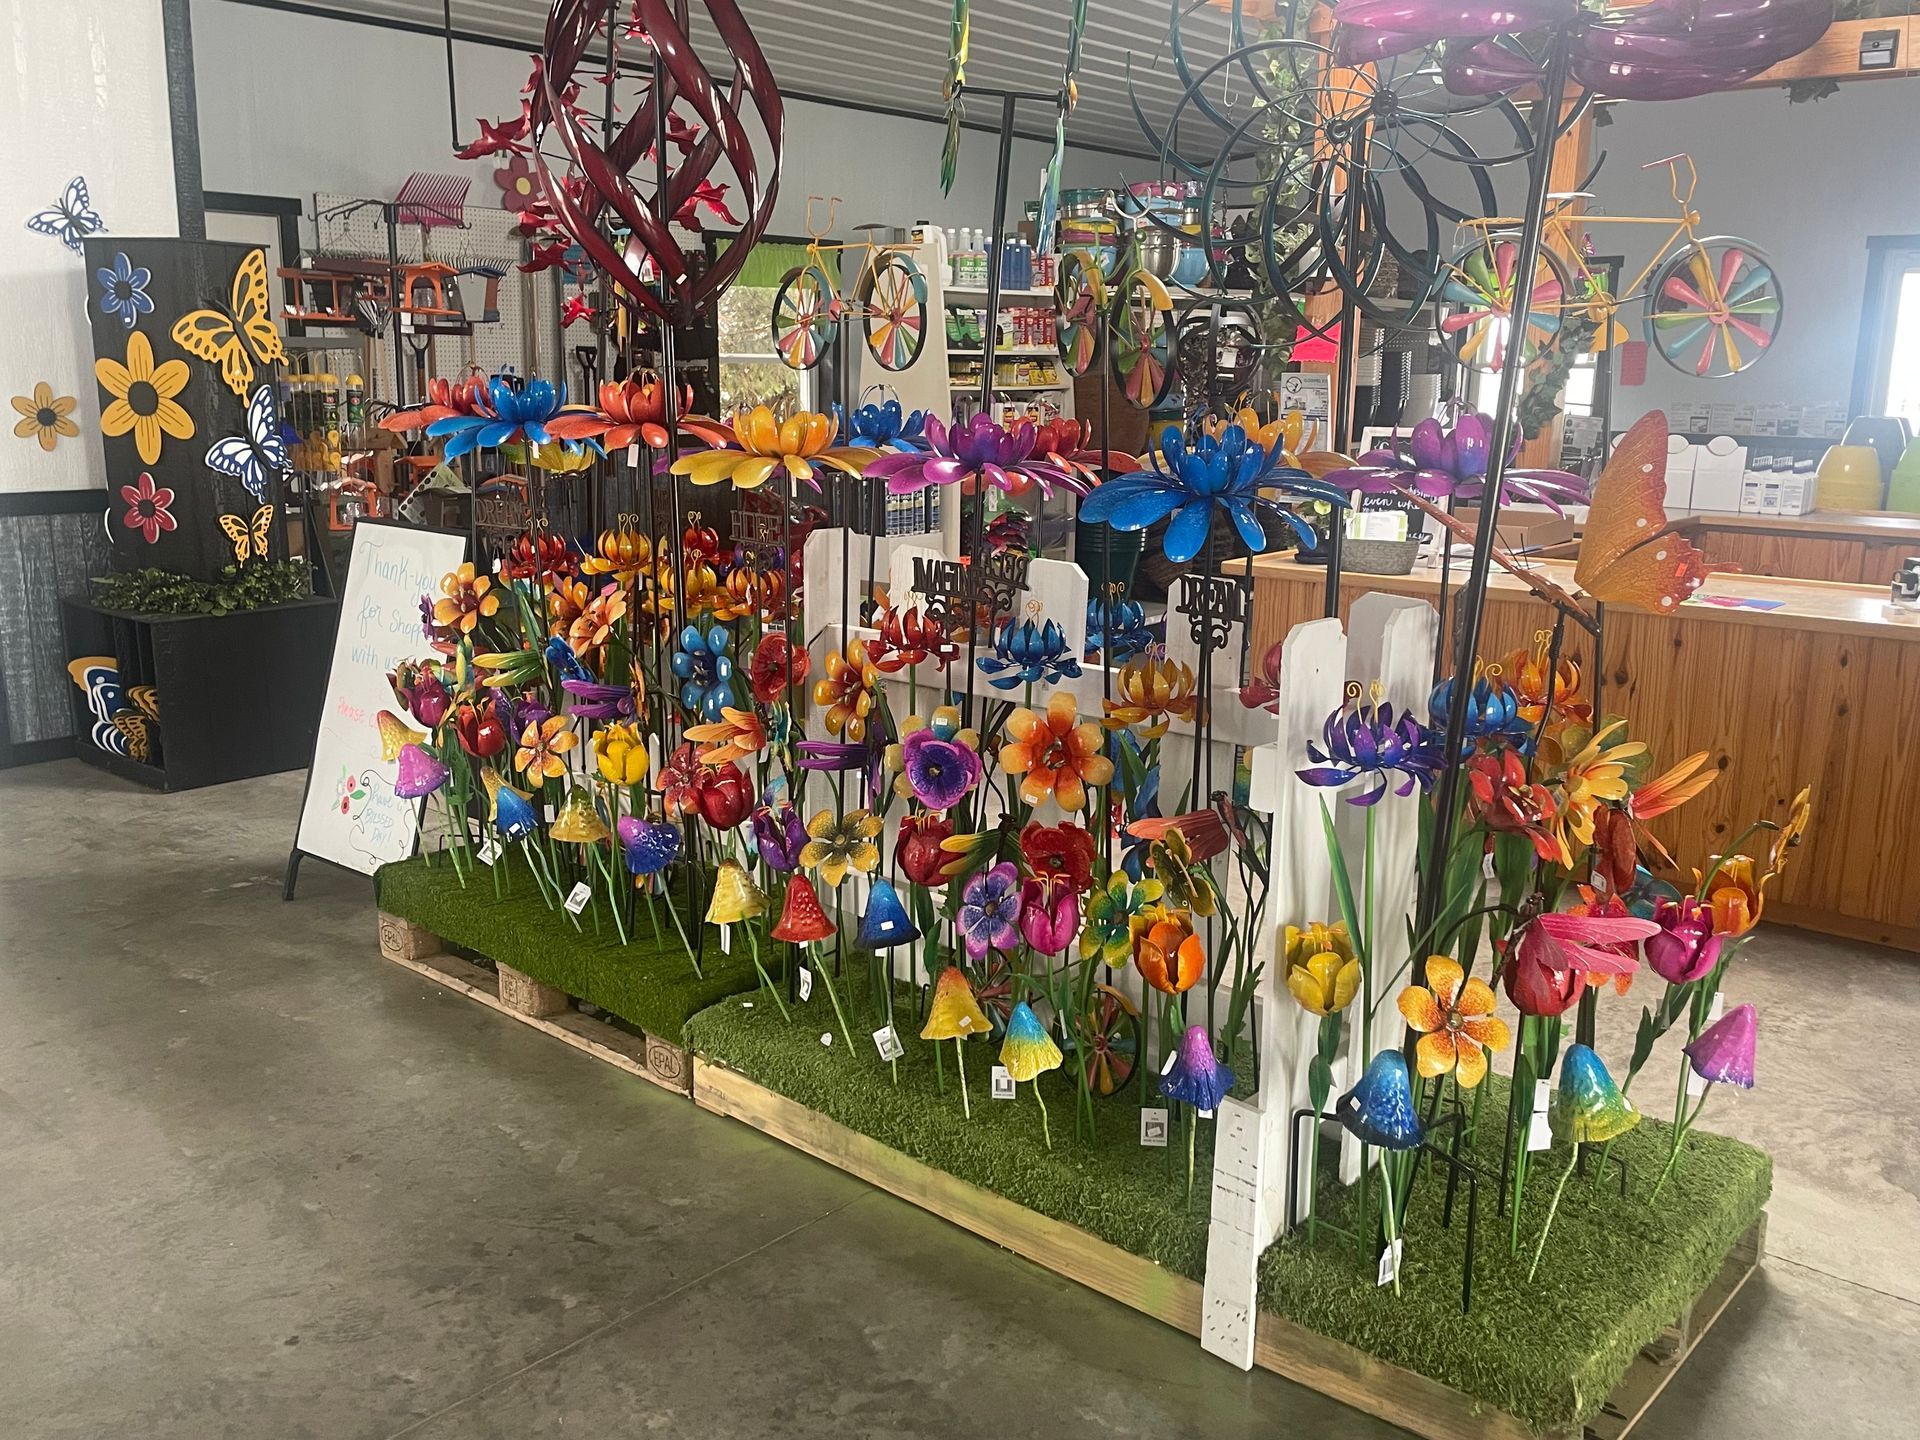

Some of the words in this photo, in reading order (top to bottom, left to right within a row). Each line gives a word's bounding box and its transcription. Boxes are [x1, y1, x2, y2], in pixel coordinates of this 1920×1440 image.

[358, 595, 382, 639] for
[352, 643, 379, 670] with
[653, 1050, 677, 1075] EPAL
